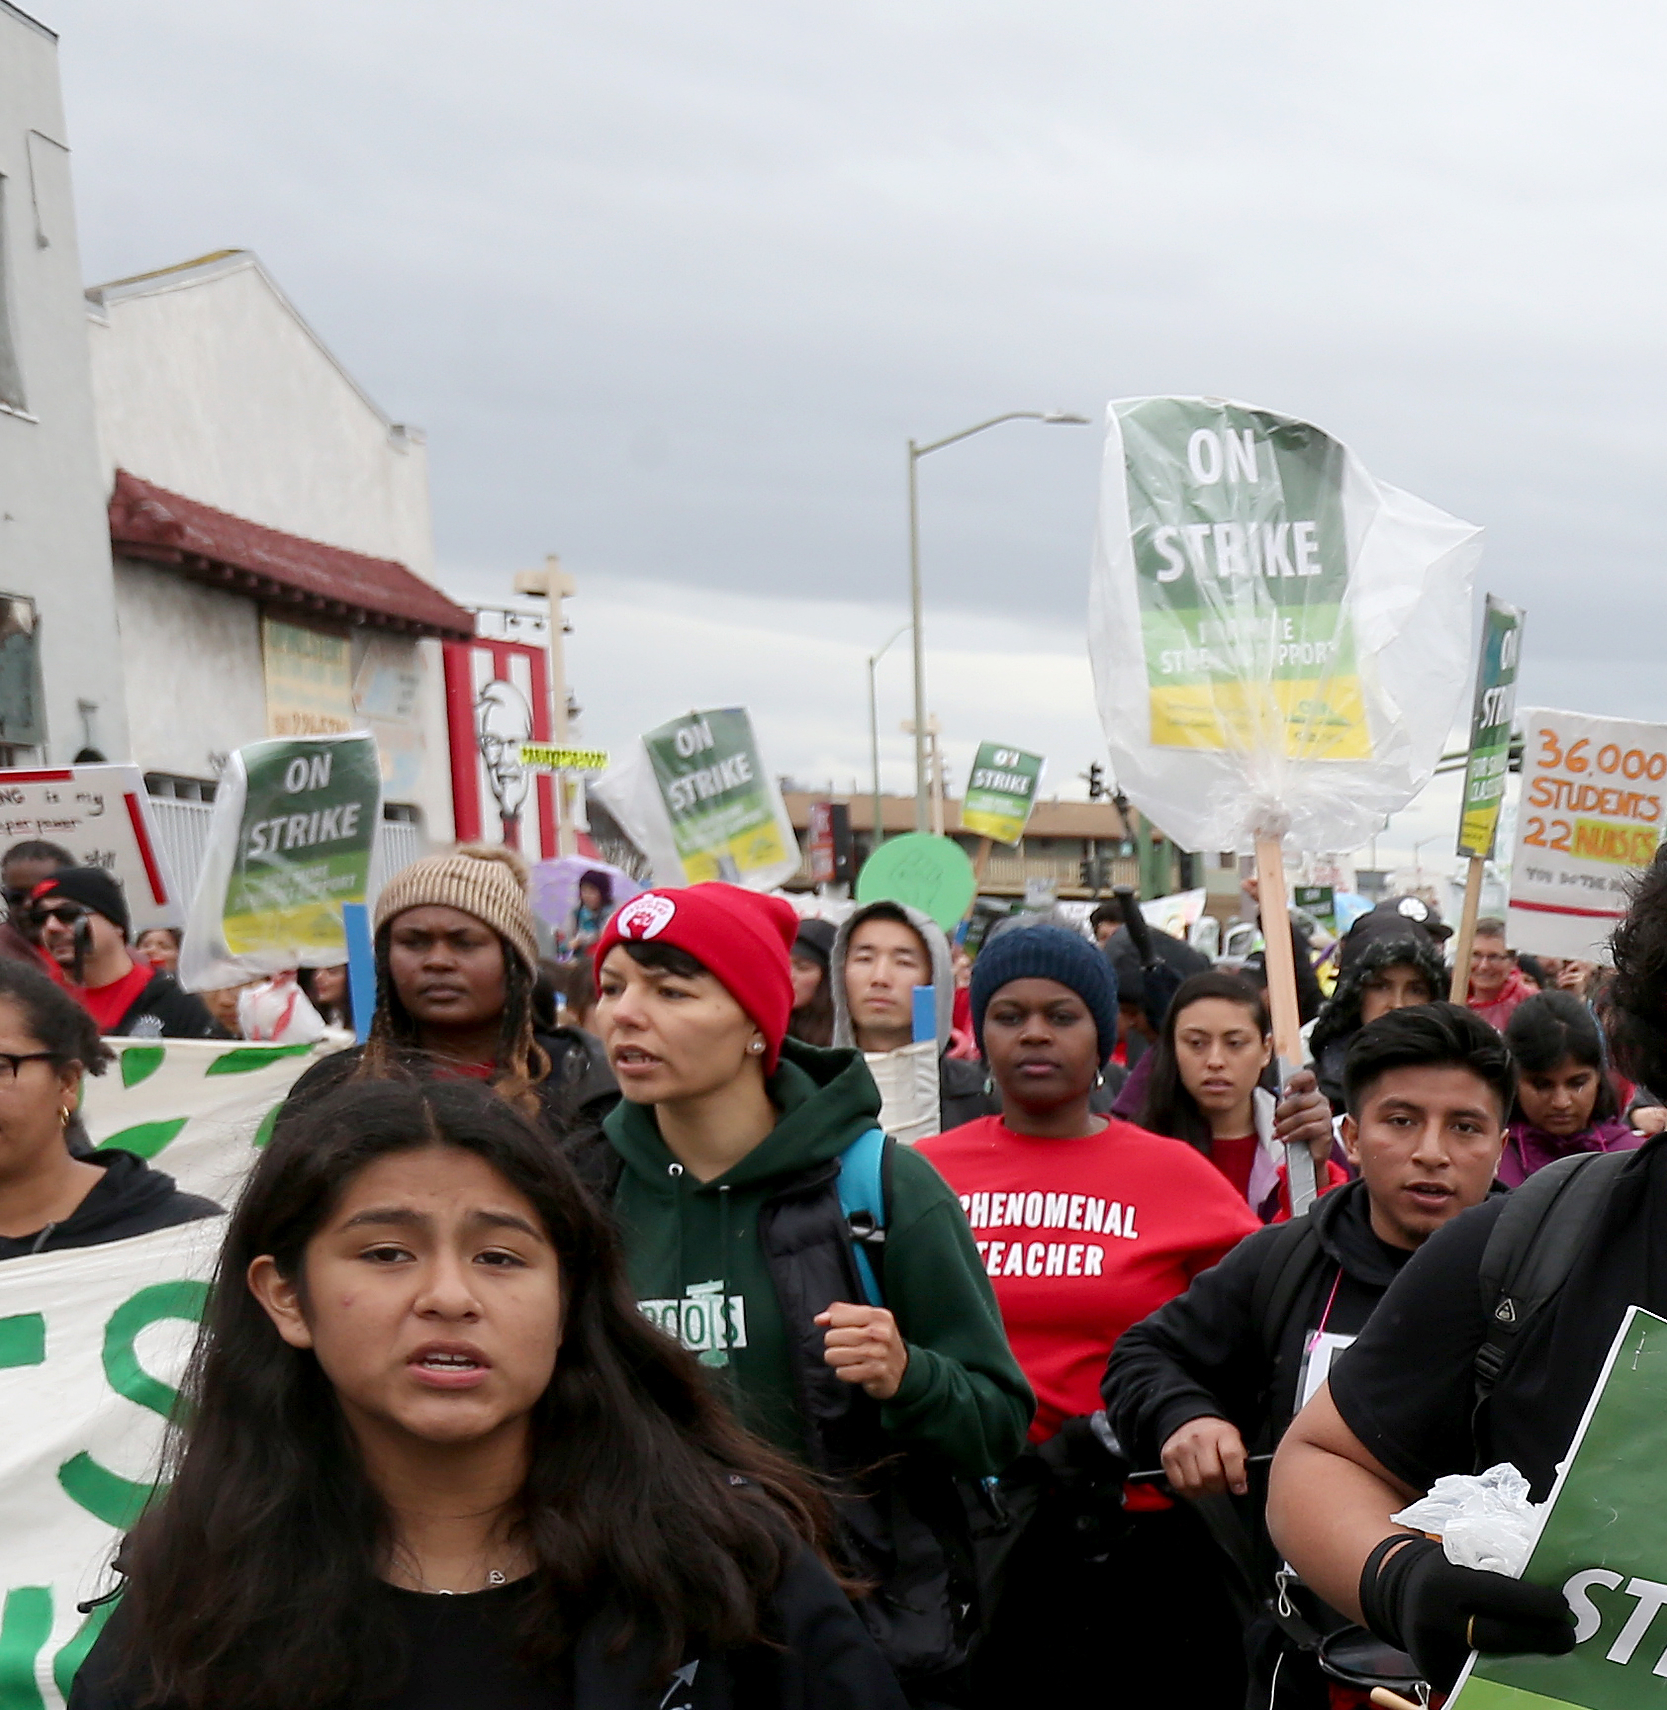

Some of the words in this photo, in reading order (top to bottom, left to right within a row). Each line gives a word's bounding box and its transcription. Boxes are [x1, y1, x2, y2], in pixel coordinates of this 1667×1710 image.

[1187, 428, 1258, 486] ON
[1154, 521, 1322, 583] STRIKE
[675, 718, 715, 758] ON
[285, 752, 333, 795] ON
[666, 752, 754, 812] STRIKE
[973, 766, 1032, 795] STRIKE
[1528, 776, 1662, 823] STUDENTS
[248, 803, 362, 857] STRIKE
[1523, 816, 1572, 853] 22
